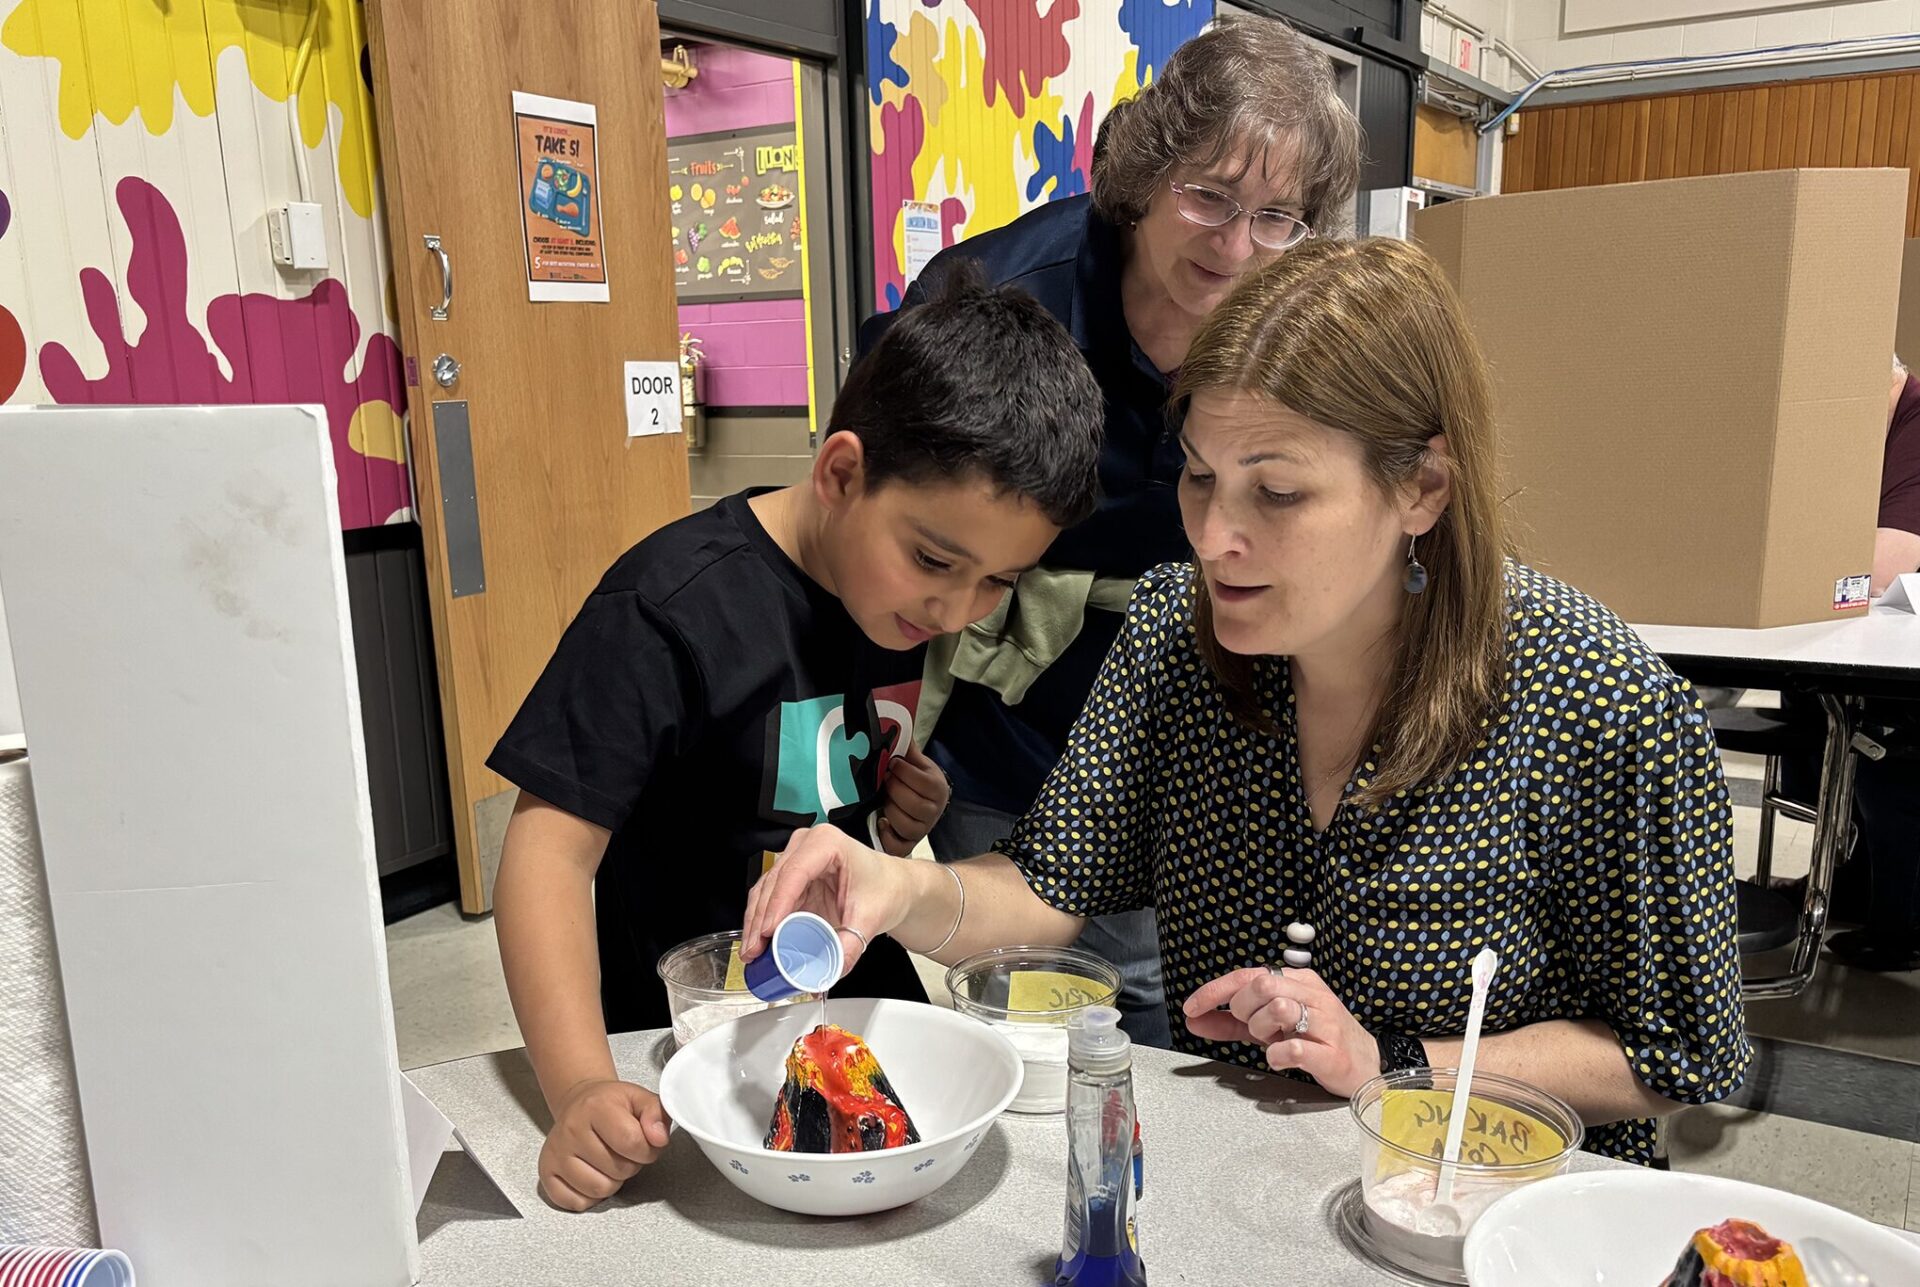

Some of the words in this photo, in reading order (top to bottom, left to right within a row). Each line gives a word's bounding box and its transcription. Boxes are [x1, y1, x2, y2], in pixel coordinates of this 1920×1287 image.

[534, 134, 566, 154] TAKE
[632, 376, 674, 395] DOOR
[651, 407, 659, 425] 2
